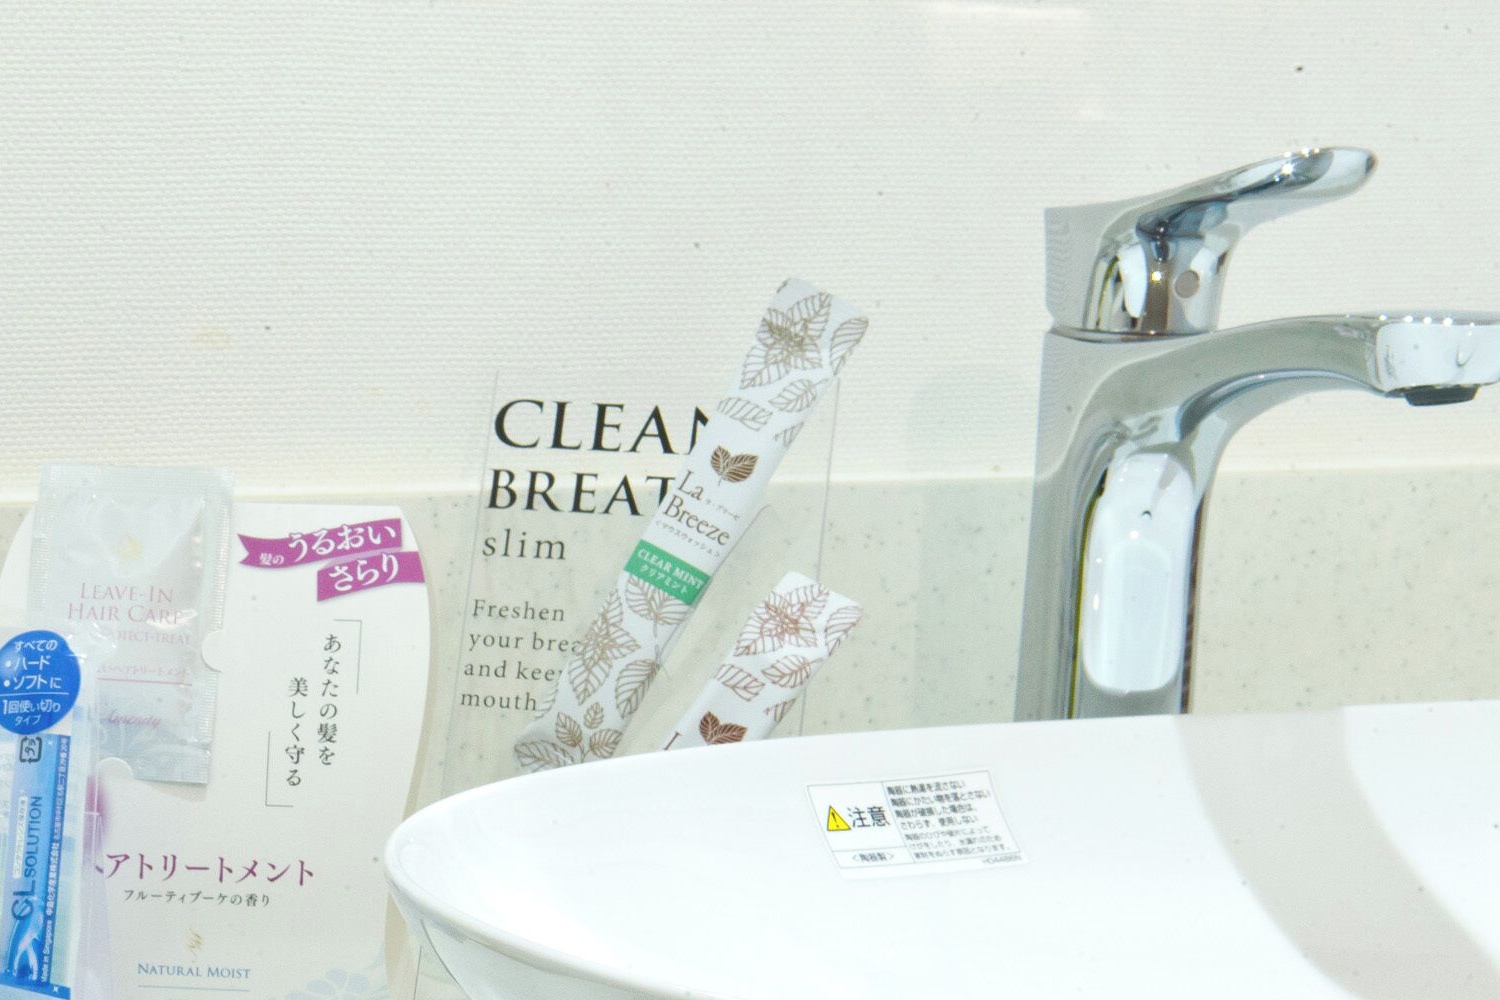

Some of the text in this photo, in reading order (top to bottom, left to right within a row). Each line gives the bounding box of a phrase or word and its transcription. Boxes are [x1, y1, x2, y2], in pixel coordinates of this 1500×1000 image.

[678, 470, 705, 502] La
[663, 494, 731, 546] Breeze
[482, 529, 566, 560] slim
[329, 553, 400, 592] さらり
[637, 548, 706, 589] CLEAR MINT
[80, 582, 173, 603] LEAVE-IN
[67, 602, 120, 622] HAIR
[472, 600, 565, 622] Freshen
[13, 639, 58, 652] すべての
[468, 632, 523, 652] your
[14, 654, 51, 671] ハード
[464, 661, 507, 680] and
[13, 673, 62, 691] ソフトに
[2, 698, 62, 715] 1回使い切り
[317, 634, 342, 766] あなたの髪を
[460, 690, 538, 712] mouth
[14, 714, 41, 726] タイプ
[285, 676, 309, 787] 美しく守る
[847, 805, 891, 828] 注意
[24, 795, 43, 879] SOLUTION
[97, 853, 316, 887] アトリートメント
[123, 888, 271, 907] フルーティブーケの香り
[137, 963, 251, 979] NATURAL MOIST
